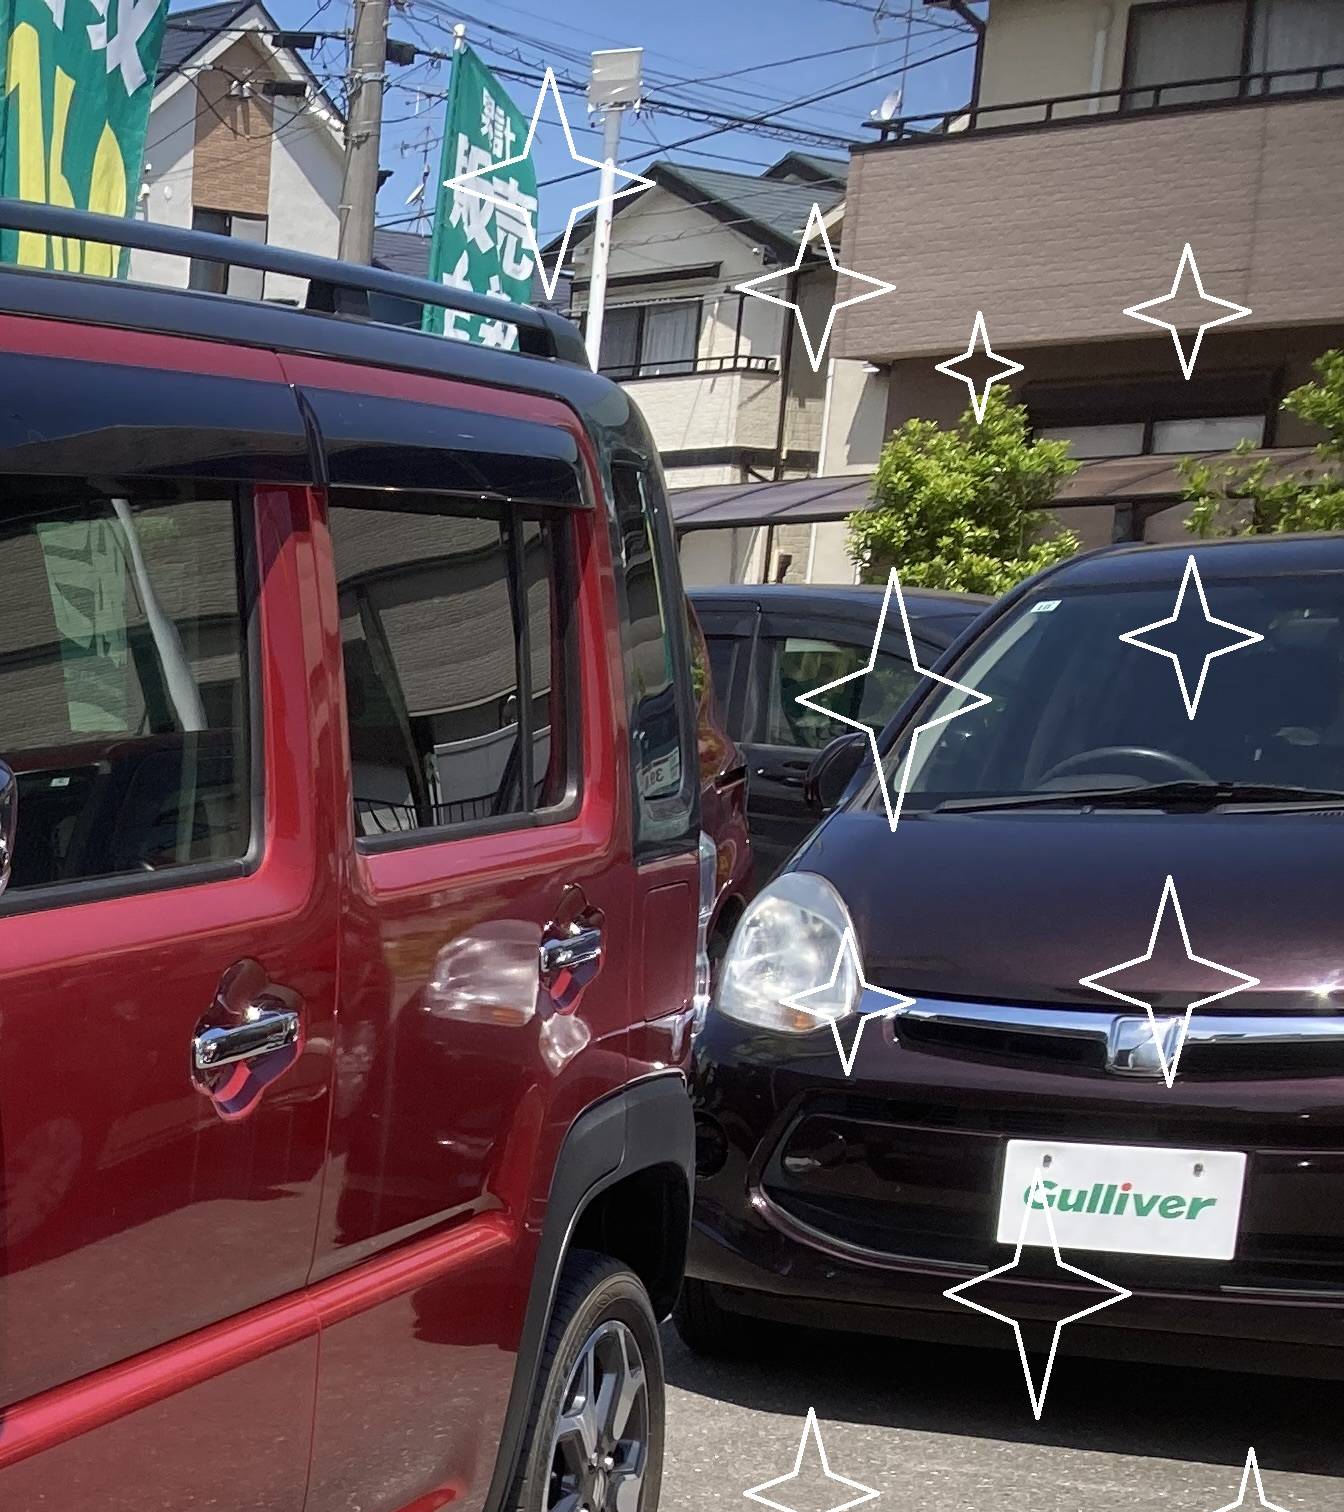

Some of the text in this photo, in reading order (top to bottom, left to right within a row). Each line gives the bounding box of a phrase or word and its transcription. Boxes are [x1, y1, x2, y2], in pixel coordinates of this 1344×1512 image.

[480, 87, 516, 159] 累計
[449, 132, 537, 281] 販売
[1023, 1180, 1218, 1220] Gulliver
